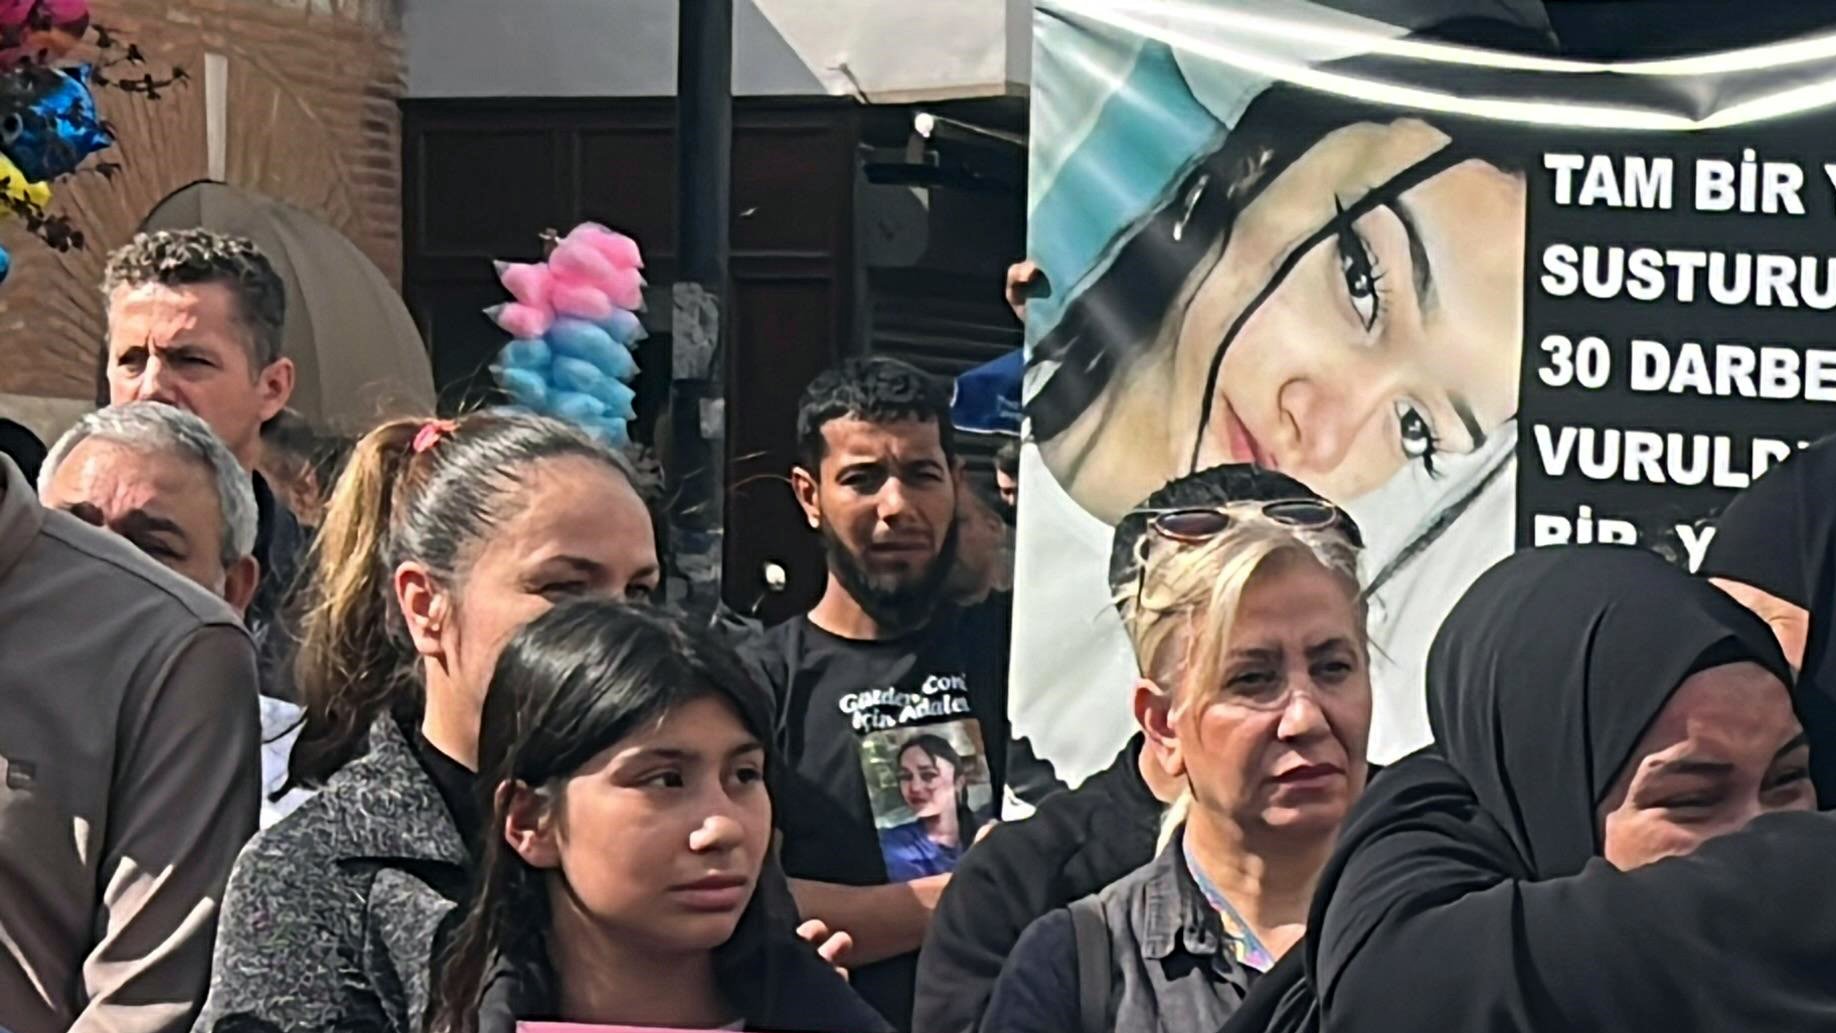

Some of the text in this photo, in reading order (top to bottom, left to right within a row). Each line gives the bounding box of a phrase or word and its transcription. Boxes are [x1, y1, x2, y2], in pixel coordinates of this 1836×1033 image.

[1544, 153, 1673, 210] TAM
[1695, 148, 1804, 215] BİR
[1538, 336, 1610, 389] 30
[1533, 423, 1808, 488] VURULD
